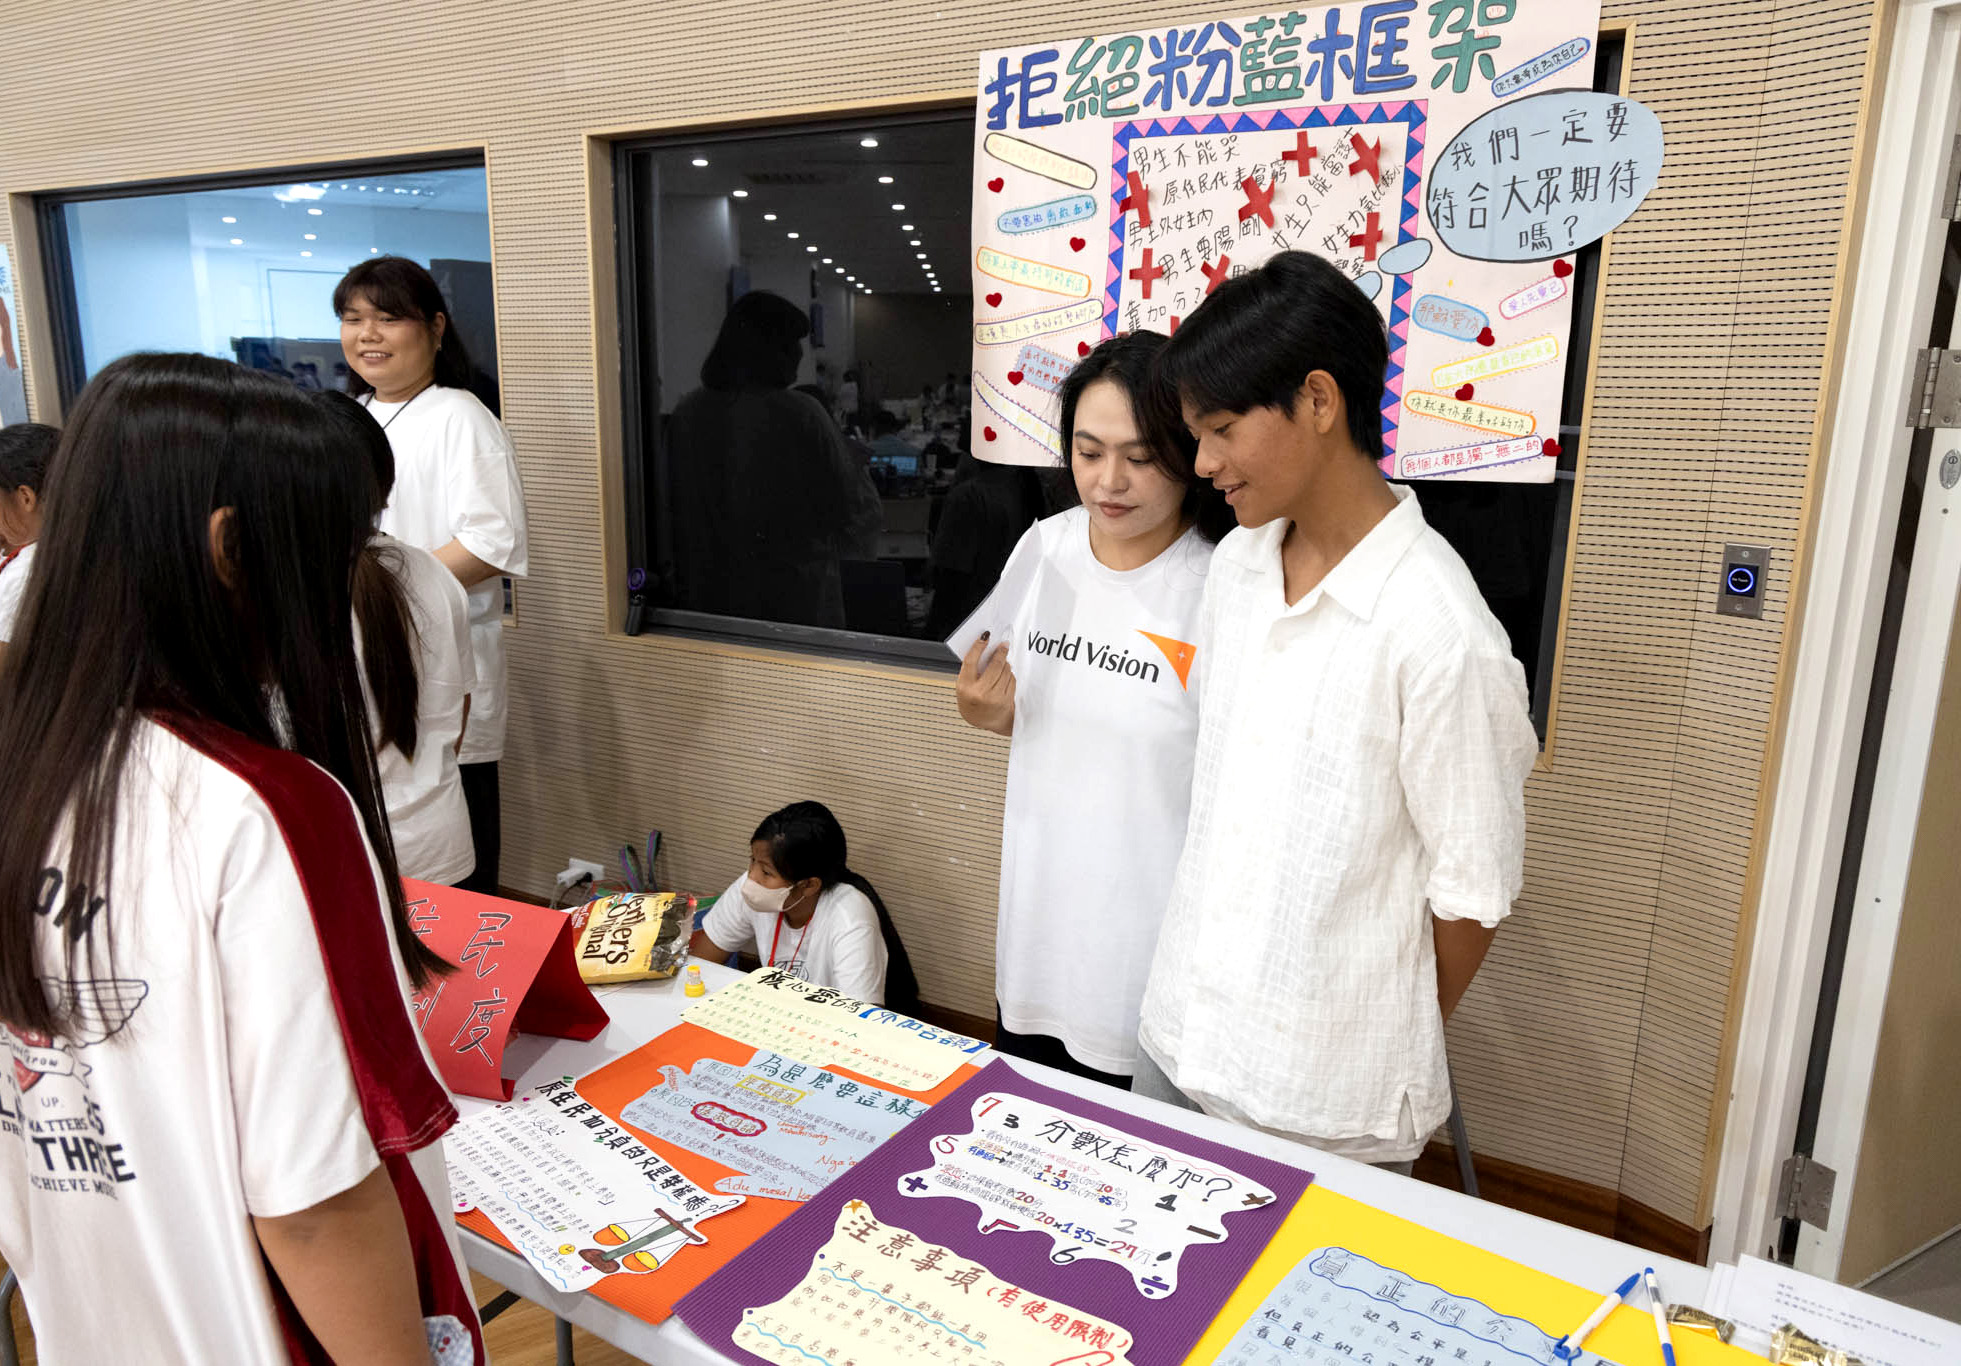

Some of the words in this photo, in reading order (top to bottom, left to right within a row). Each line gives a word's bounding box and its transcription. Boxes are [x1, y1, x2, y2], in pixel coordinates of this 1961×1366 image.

[984, 0, 1517, 130] 拒絕粉藍框架
[1132, 134, 1240, 180] 男生不能哭
[1450, 101, 1631, 172] 我們一定要
[1163, 159, 1288, 206] 原住民代表貧窮
[1431, 159, 1642, 231] 符合大眾期待
[1128, 208, 1214, 250] 男主外女主內
[1157, 215, 1262, 287] 男生要陽剛
[1518, 214, 1579, 252] 嗎?
[1404, 438, 1540, 475] 每個人都是獨一無二的
[1087, 642, 1159, 683] Vision
[582, 902, 629, 960] Original
[605, 893, 648, 966] erther's
[757, 970, 864, 1013] 核心密碼
[978, 1096, 1003, 1118] 7
[1002, 1113, 1020, 1129] 3
[935, 1135, 959, 1155] 5
[1034, 1118, 1233, 1203] 分數怎麼加?
[1154, 1194, 1178, 1213] 1
[1113, 1218, 1138, 1236] 2
[1051, 1246, 1083, 1264] 6
[841, 1214, 986, 1295] 注意事項
[986, 1286, 1129, 1350] (有使用限制)
[1316, 1250, 1557, 1364] 真正的公
